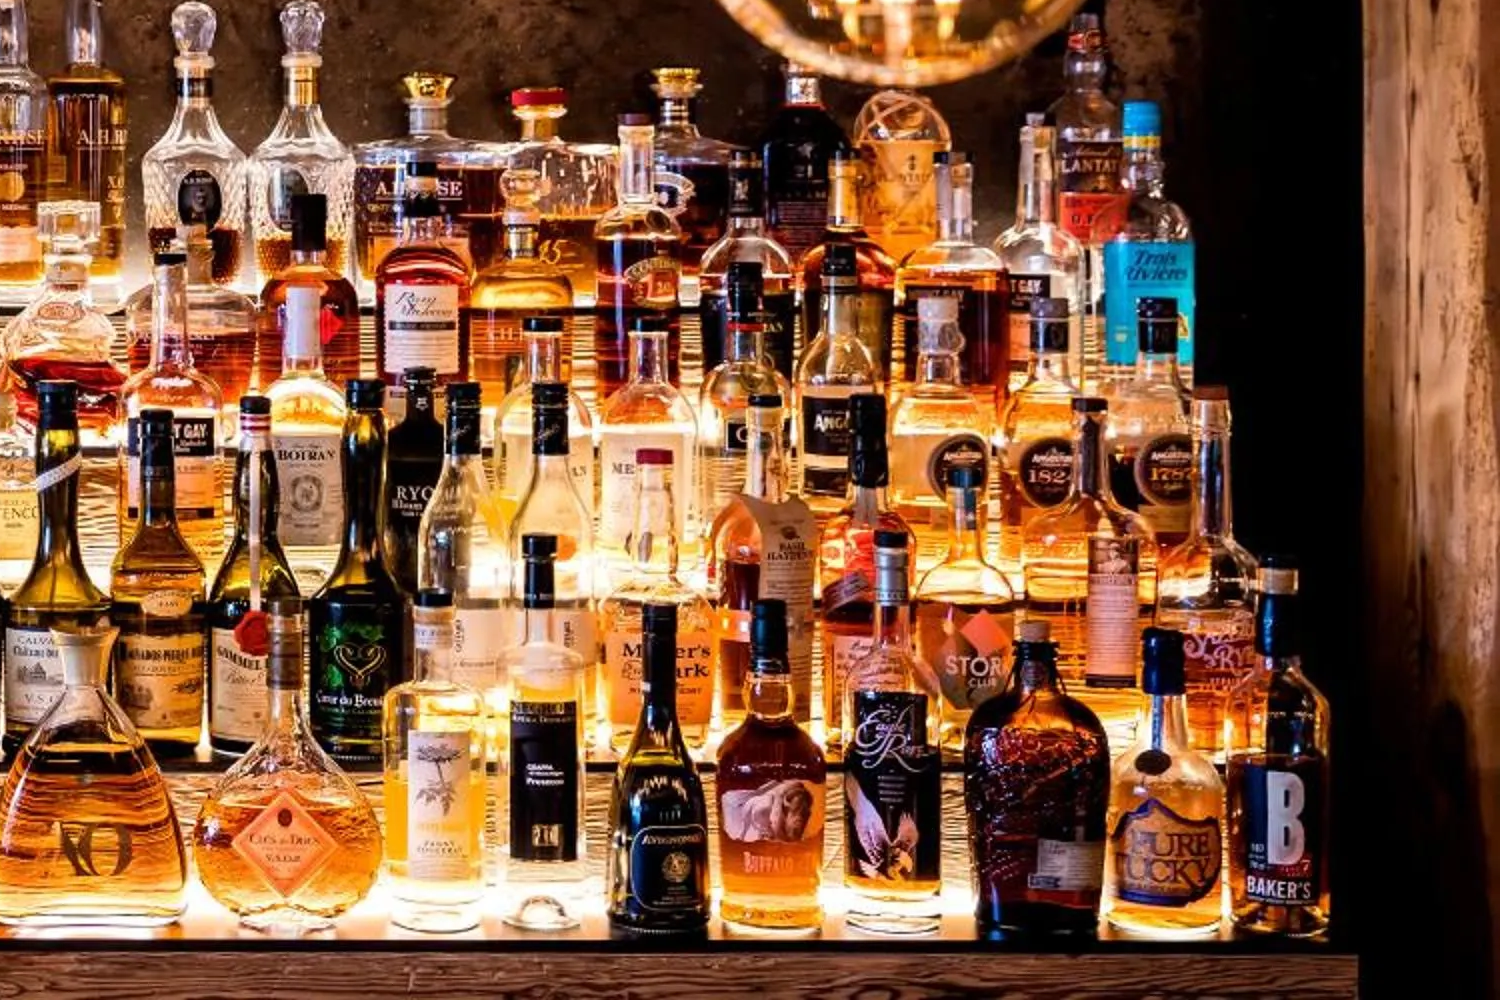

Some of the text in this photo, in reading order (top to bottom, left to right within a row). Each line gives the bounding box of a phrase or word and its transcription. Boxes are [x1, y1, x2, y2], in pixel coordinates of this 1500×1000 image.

[184, 424, 208, 440] GAY
[278, 450, 336, 461] BOTRAN
[397, 486, 435, 501] RYO
[17, 635, 55, 645] CALVA
[622, 643, 712, 659] Mer's
[945, 655, 1002, 677] STOR
[1267, 771, 1305, 865] B
[743, 851, 794, 874] BUFFALO
[1247, 875, 1312, 899] BAKER'S
